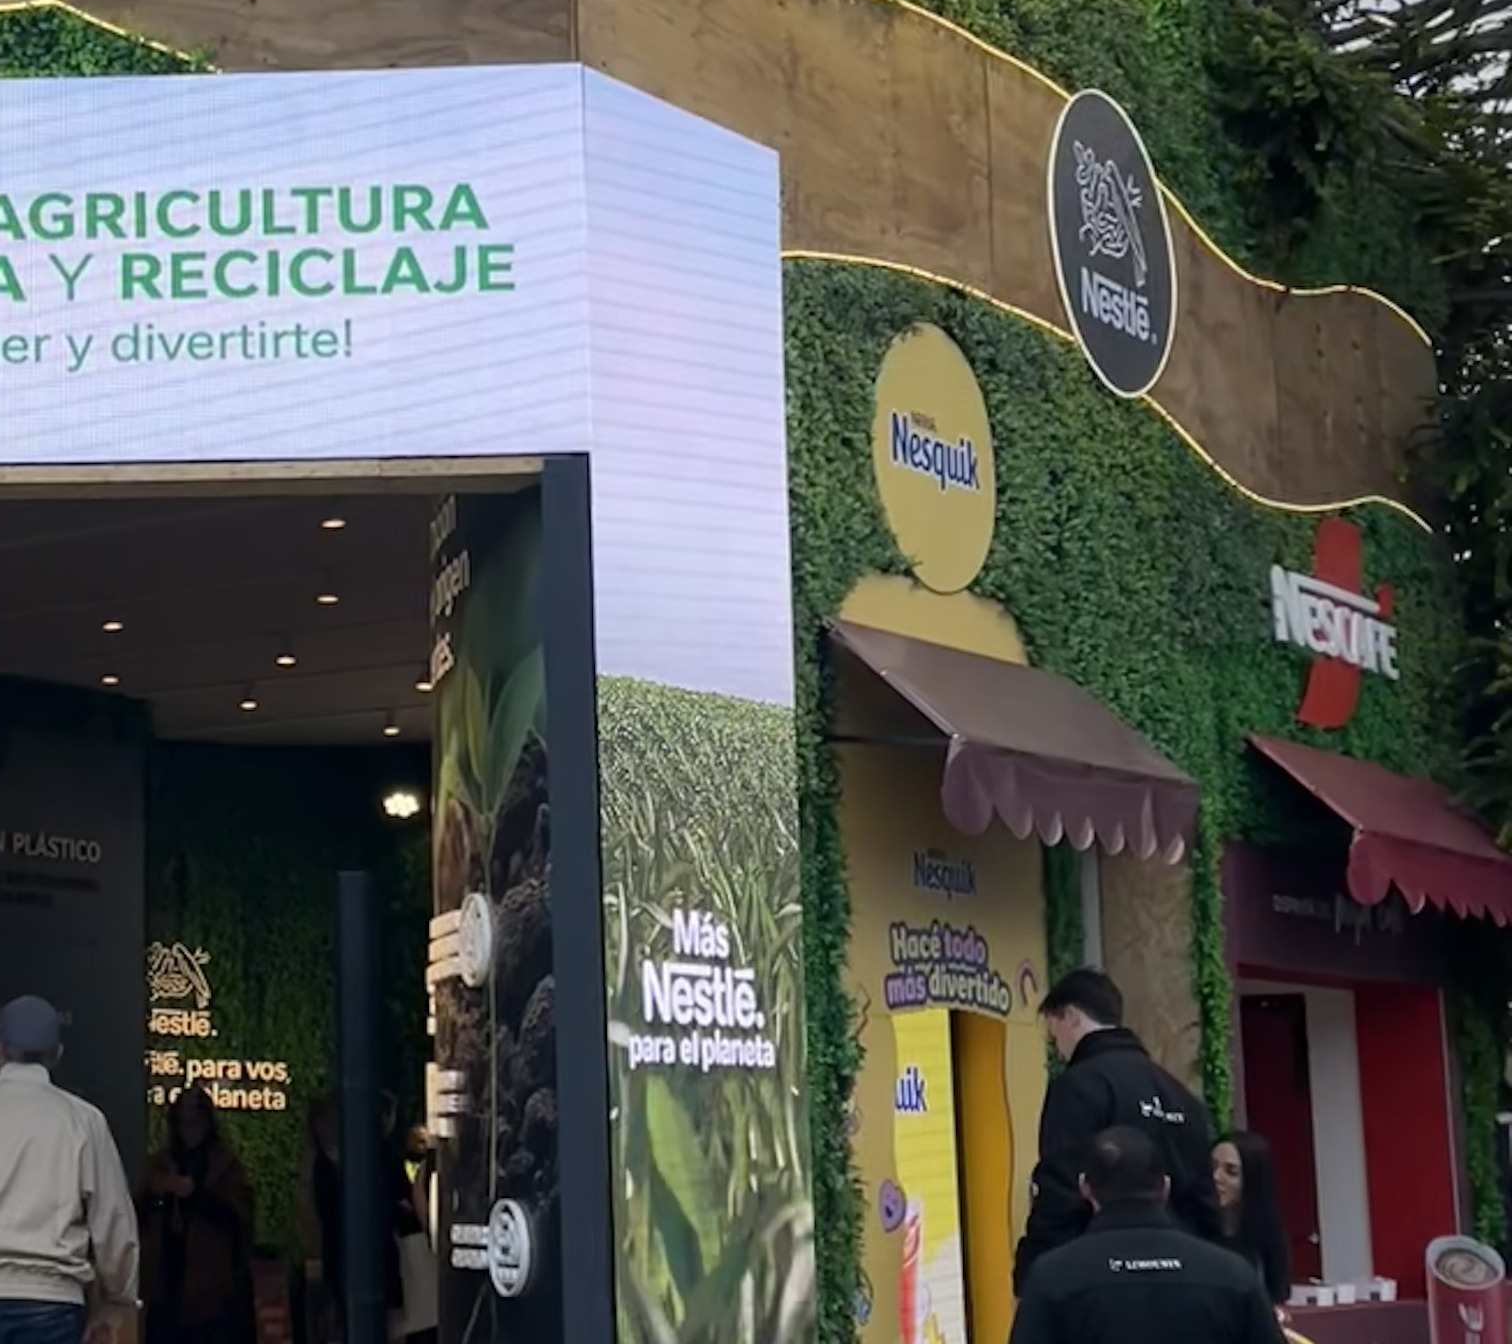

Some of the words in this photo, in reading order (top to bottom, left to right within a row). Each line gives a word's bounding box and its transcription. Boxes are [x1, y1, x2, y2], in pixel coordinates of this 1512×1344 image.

[49, 253, 93, 301] Y
[121, 244, 516, 301] RECICLAJE
[66, 332, 92, 373] y
[111, 319, 353, 363] divertirte!
[891, 410, 981, 492] Nesquik
[11, 830, 102, 863] PLÁSTICO
[913, 851, 976, 899] Nesquik
[672, 907, 730, 958] Más
[890, 920, 942, 962] Hacé
[944, 925, 987, 964] todo
[886, 968, 928, 1006] más
[928, 967, 1011, 1012] divertido
[185, 1058, 242, 1089] para
[244, 1059, 292, 1085] vos,
[628, 1033, 676, 1071] para
[679, 1029, 699, 1066] el
[701, 1028, 777, 1073] planeta
